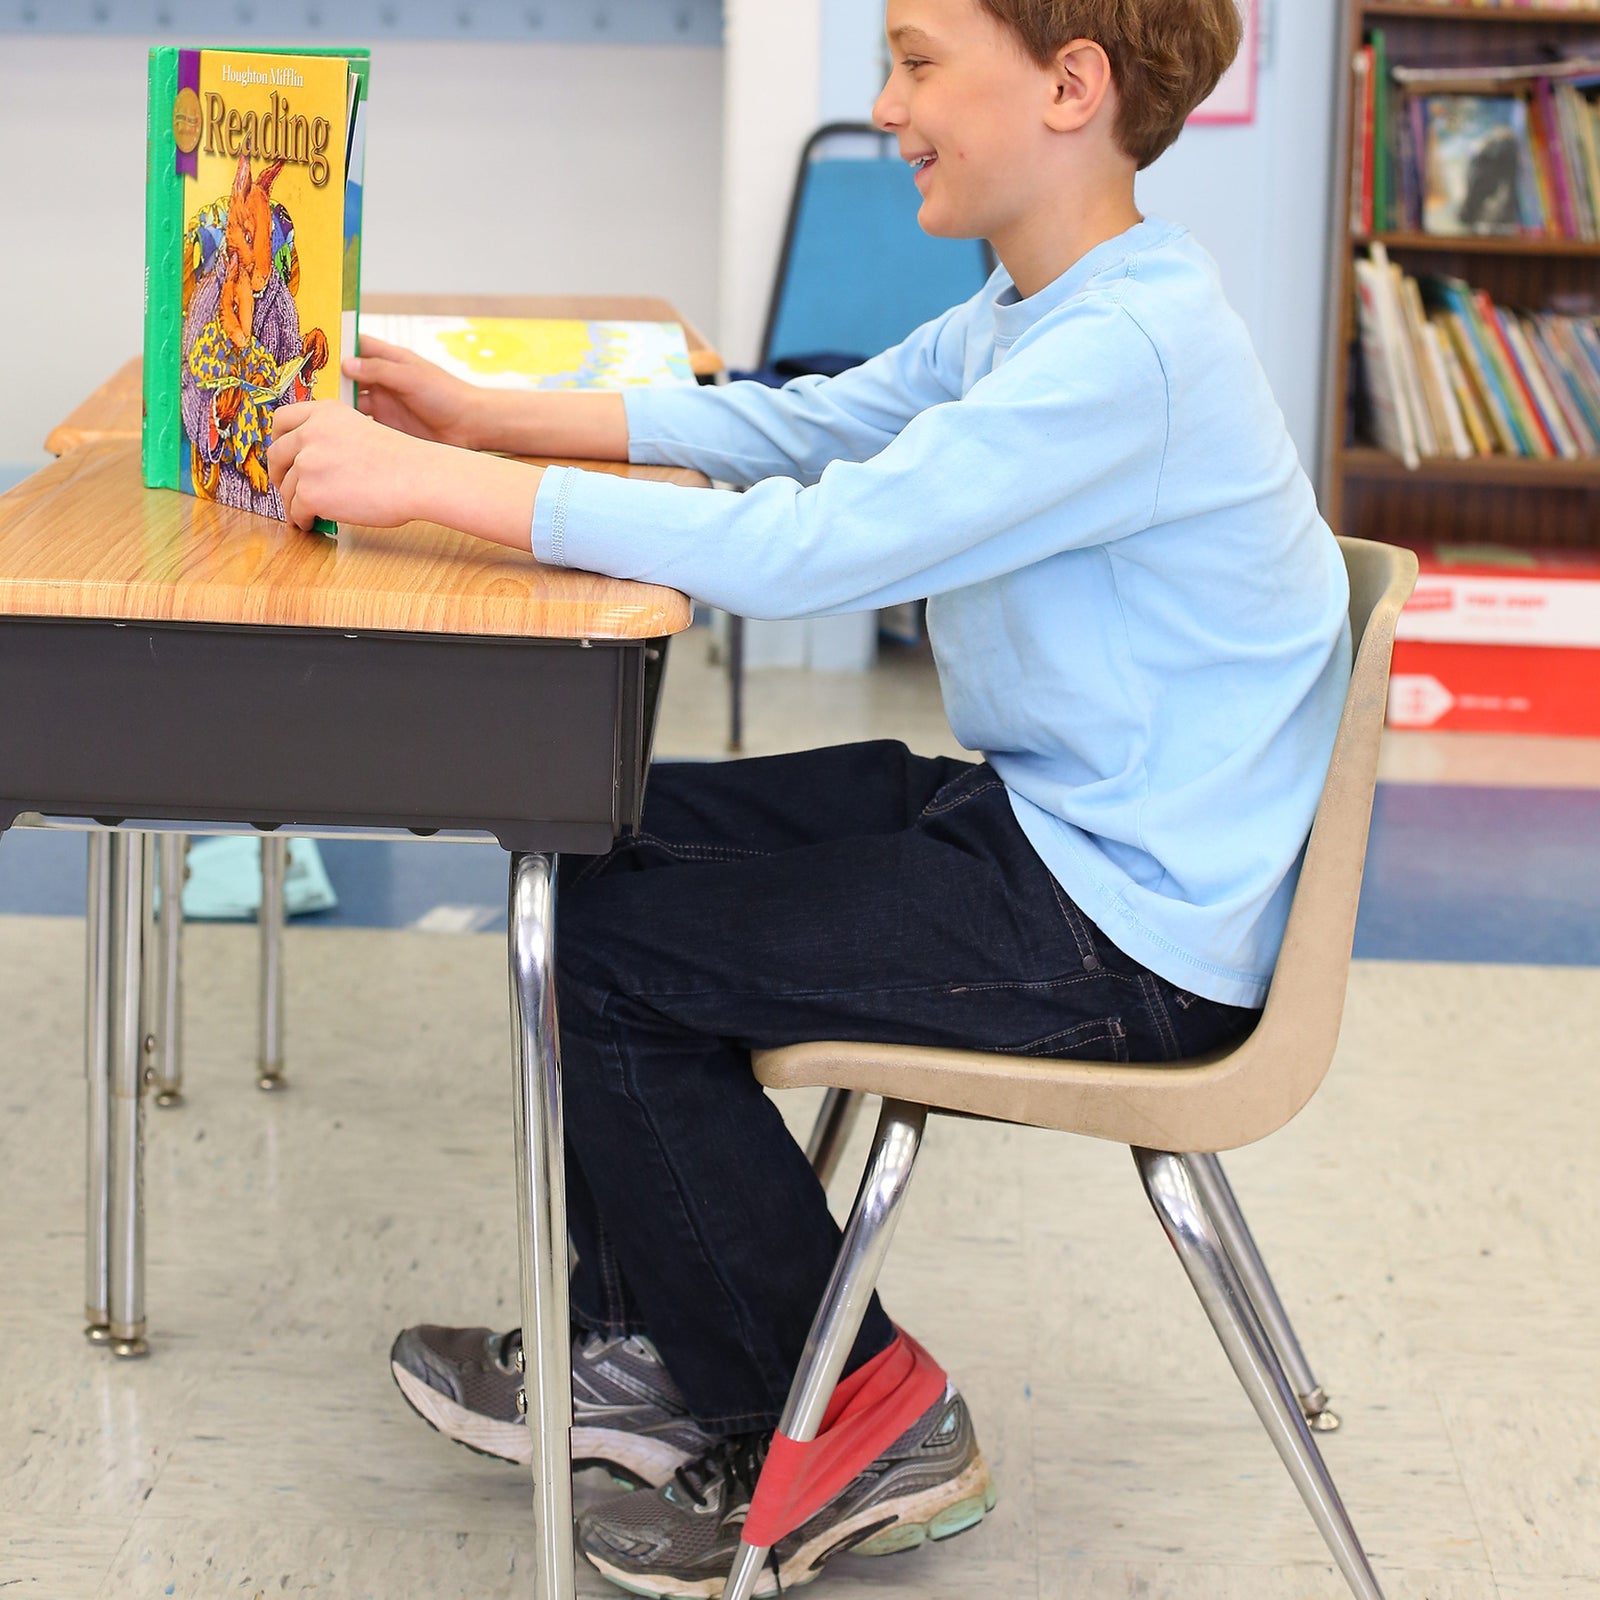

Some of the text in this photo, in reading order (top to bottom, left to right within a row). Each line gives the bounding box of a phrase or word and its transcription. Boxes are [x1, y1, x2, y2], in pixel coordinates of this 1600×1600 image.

[222, 64, 304, 87] Houghton Mifflin
[204, 90, 329, 186] Reading
